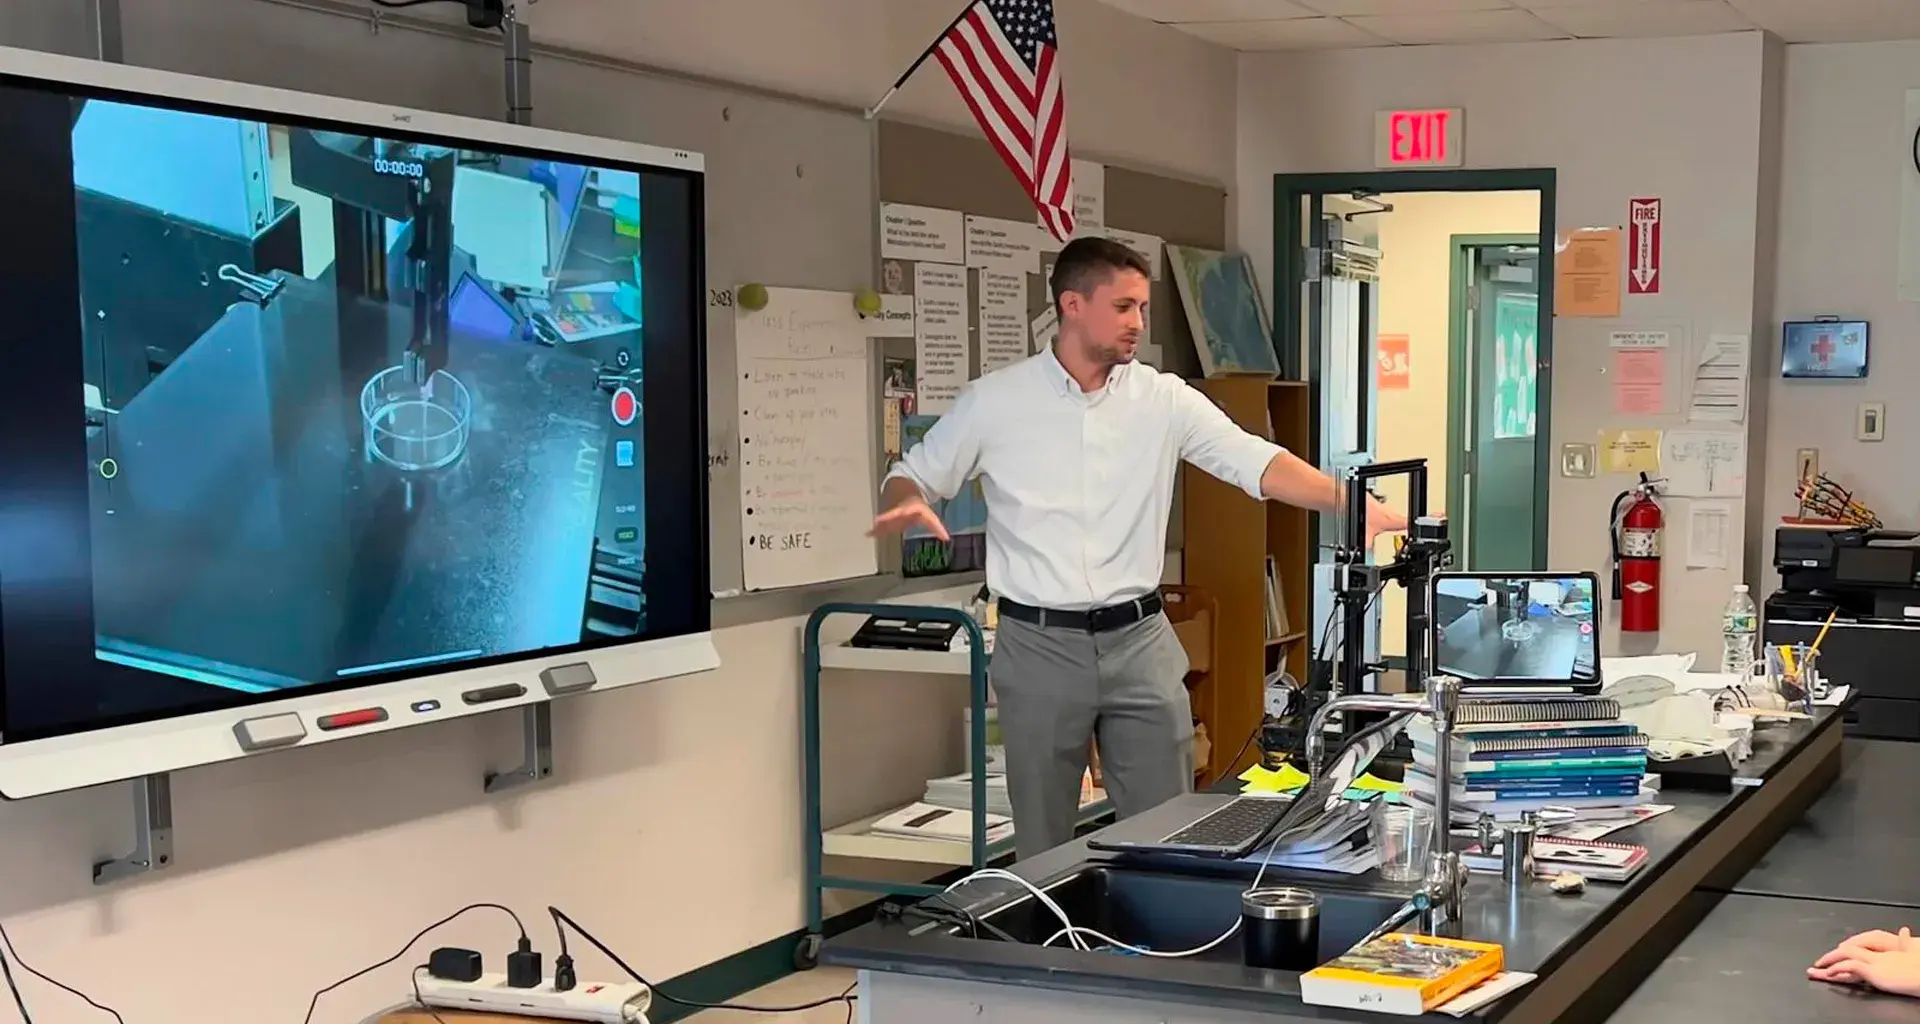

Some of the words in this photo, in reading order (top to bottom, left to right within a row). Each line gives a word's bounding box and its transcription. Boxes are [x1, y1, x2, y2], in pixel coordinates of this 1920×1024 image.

[1391, 112, 1448, 162] EXIT
[374, 159, 423, 177] 00:00:00
[1635, 207, 1656, 220] FIRE
[710, 289, 733, 307] 2023
[759, 533, 775, 551] BE
[780, 531, 813, 551] SAFE
